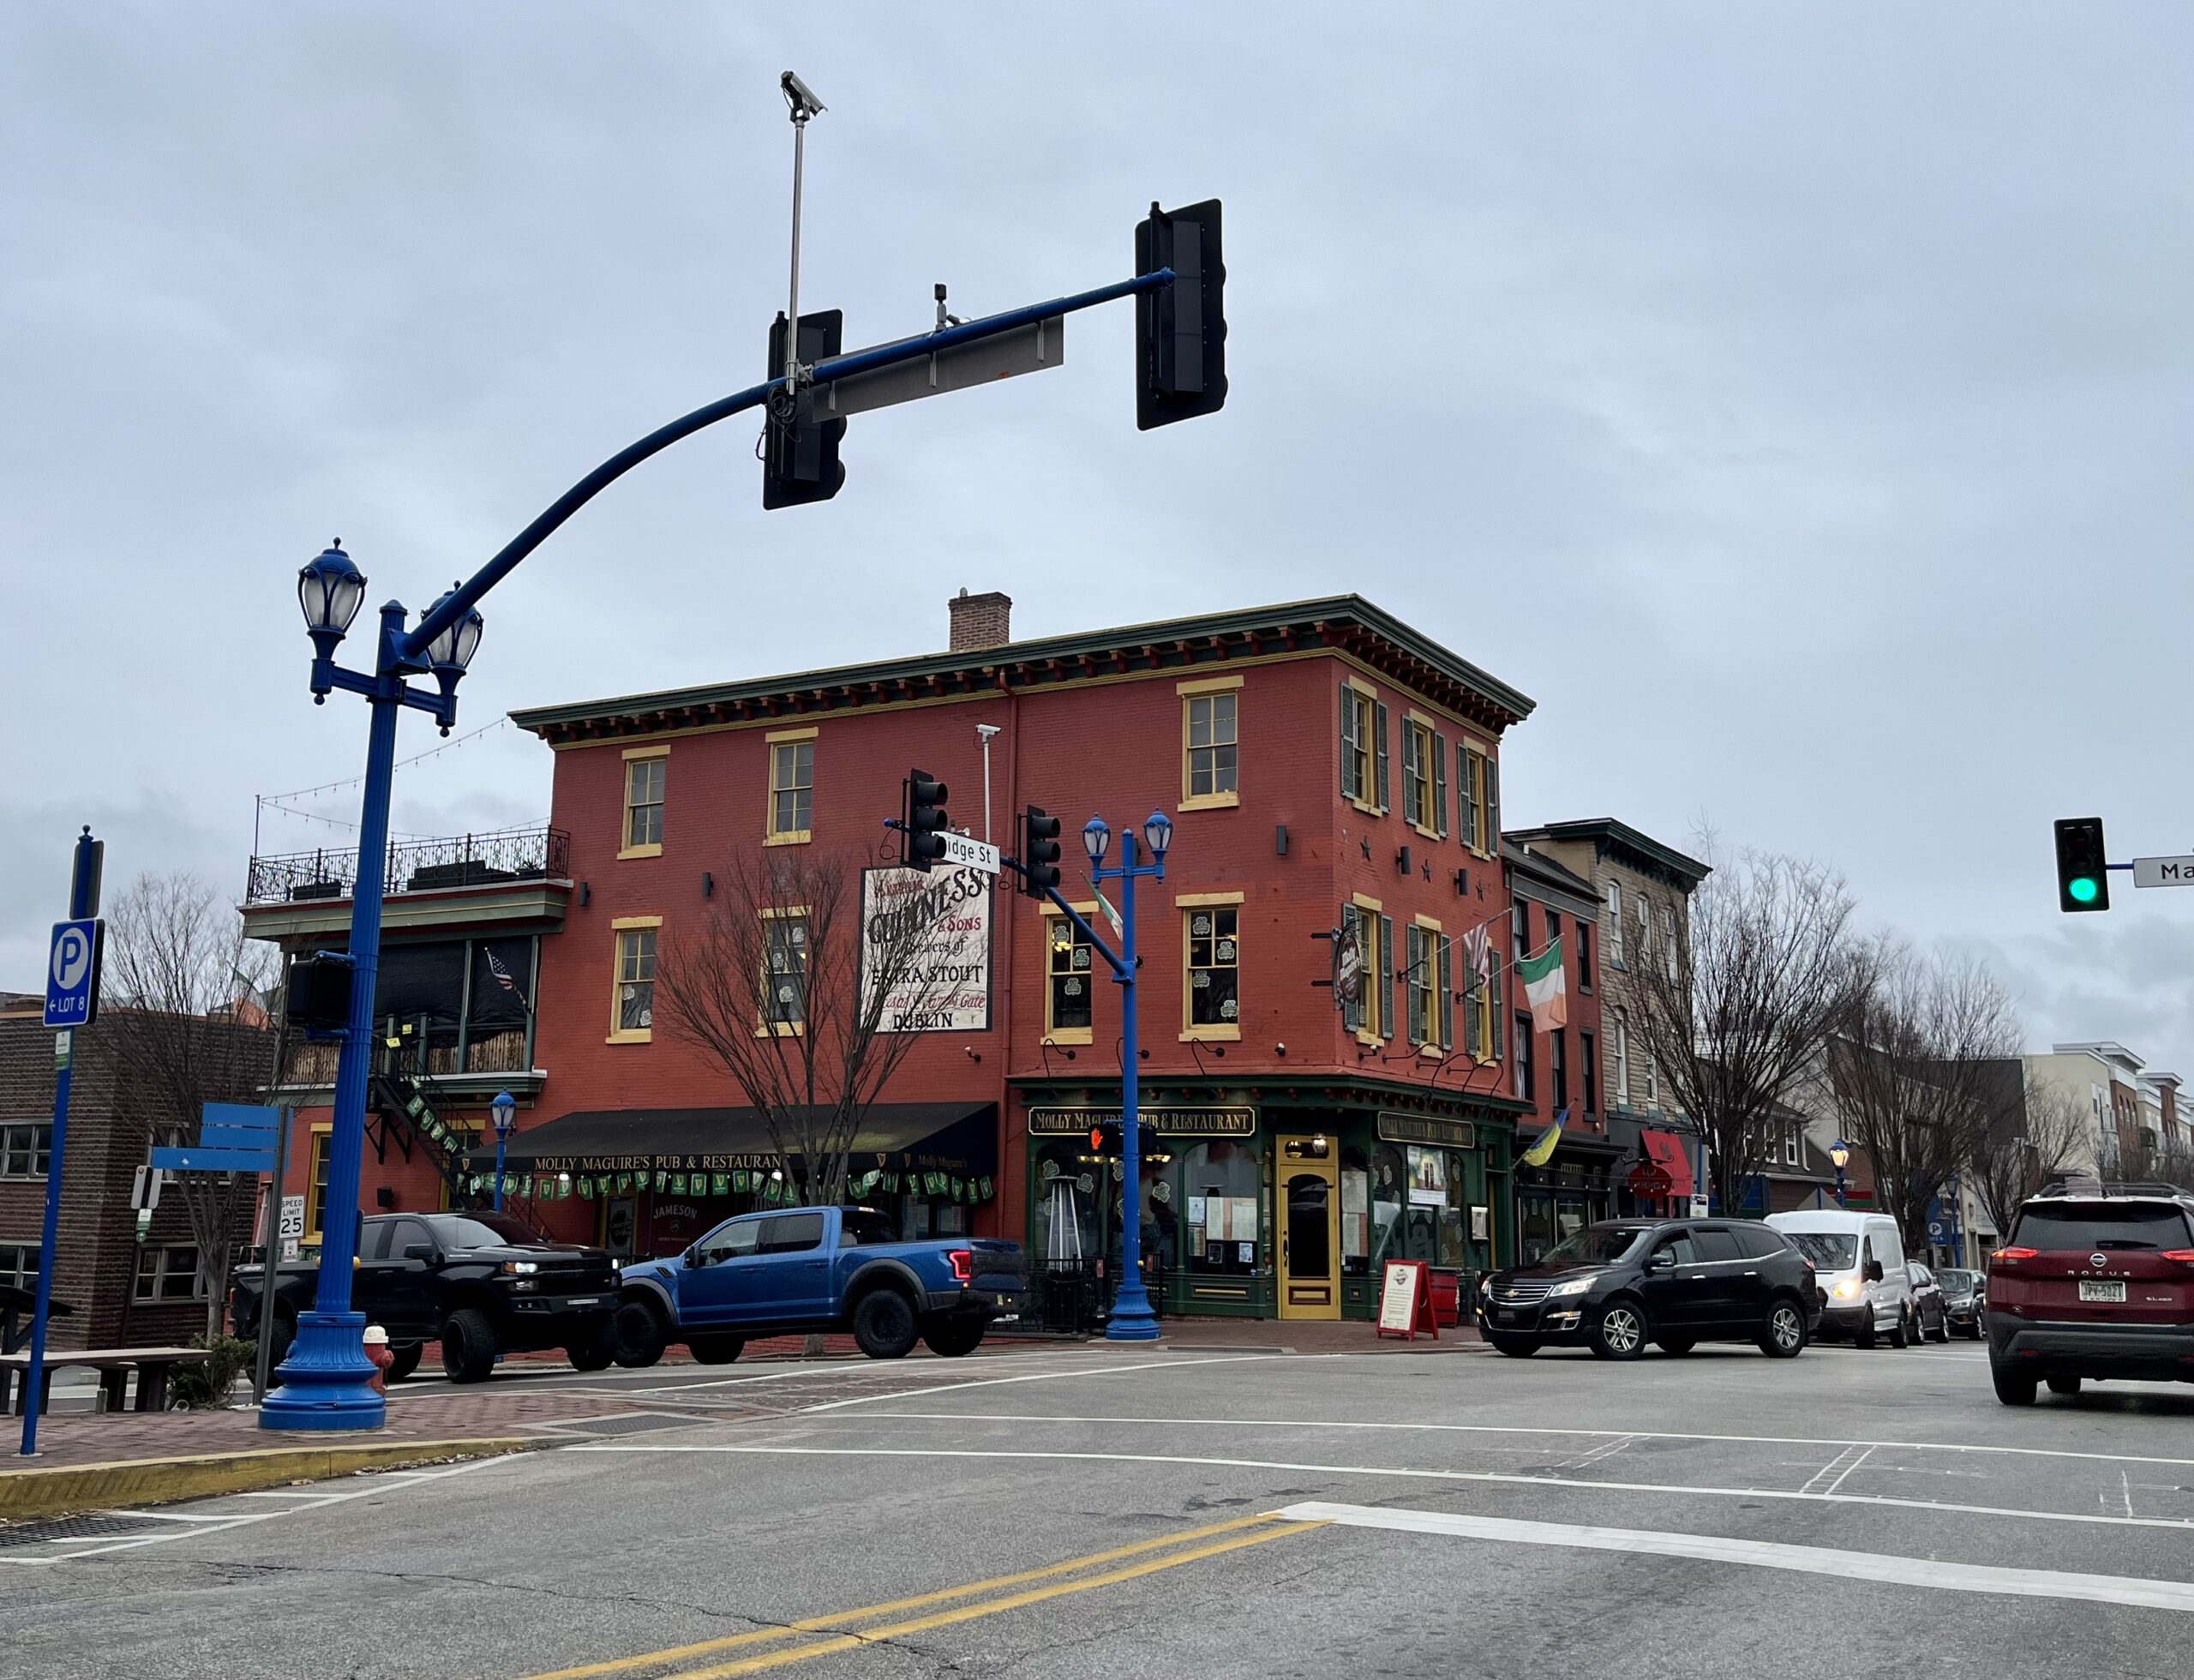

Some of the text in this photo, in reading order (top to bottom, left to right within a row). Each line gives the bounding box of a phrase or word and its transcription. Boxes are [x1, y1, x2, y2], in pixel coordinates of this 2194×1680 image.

[948, 837, 991, 864] idge St
[59, 936, 81, 981] P
[928, 965, 983, 983] STOUT
[58, 996, 85, 1013] LOT 8
[960, 993, 986, 1009] Gate
[892, 1012, 953, 1029] DUBLIN
[1035, 1113, 1071, 1130] MOLLY
[1171, 1113, 1249, 1130] RESTAURANT
[535, 1158, 577, 1171] MOLLY
[582, 1156, 650, 1170] MAGUIRE'S
[656, 1155, 680, 1169] PUB
[686, 1156, 696, 1169] &
[653, 1205, 698, 1219] JAMESON
[281, 1217, 302, 1234] 25
